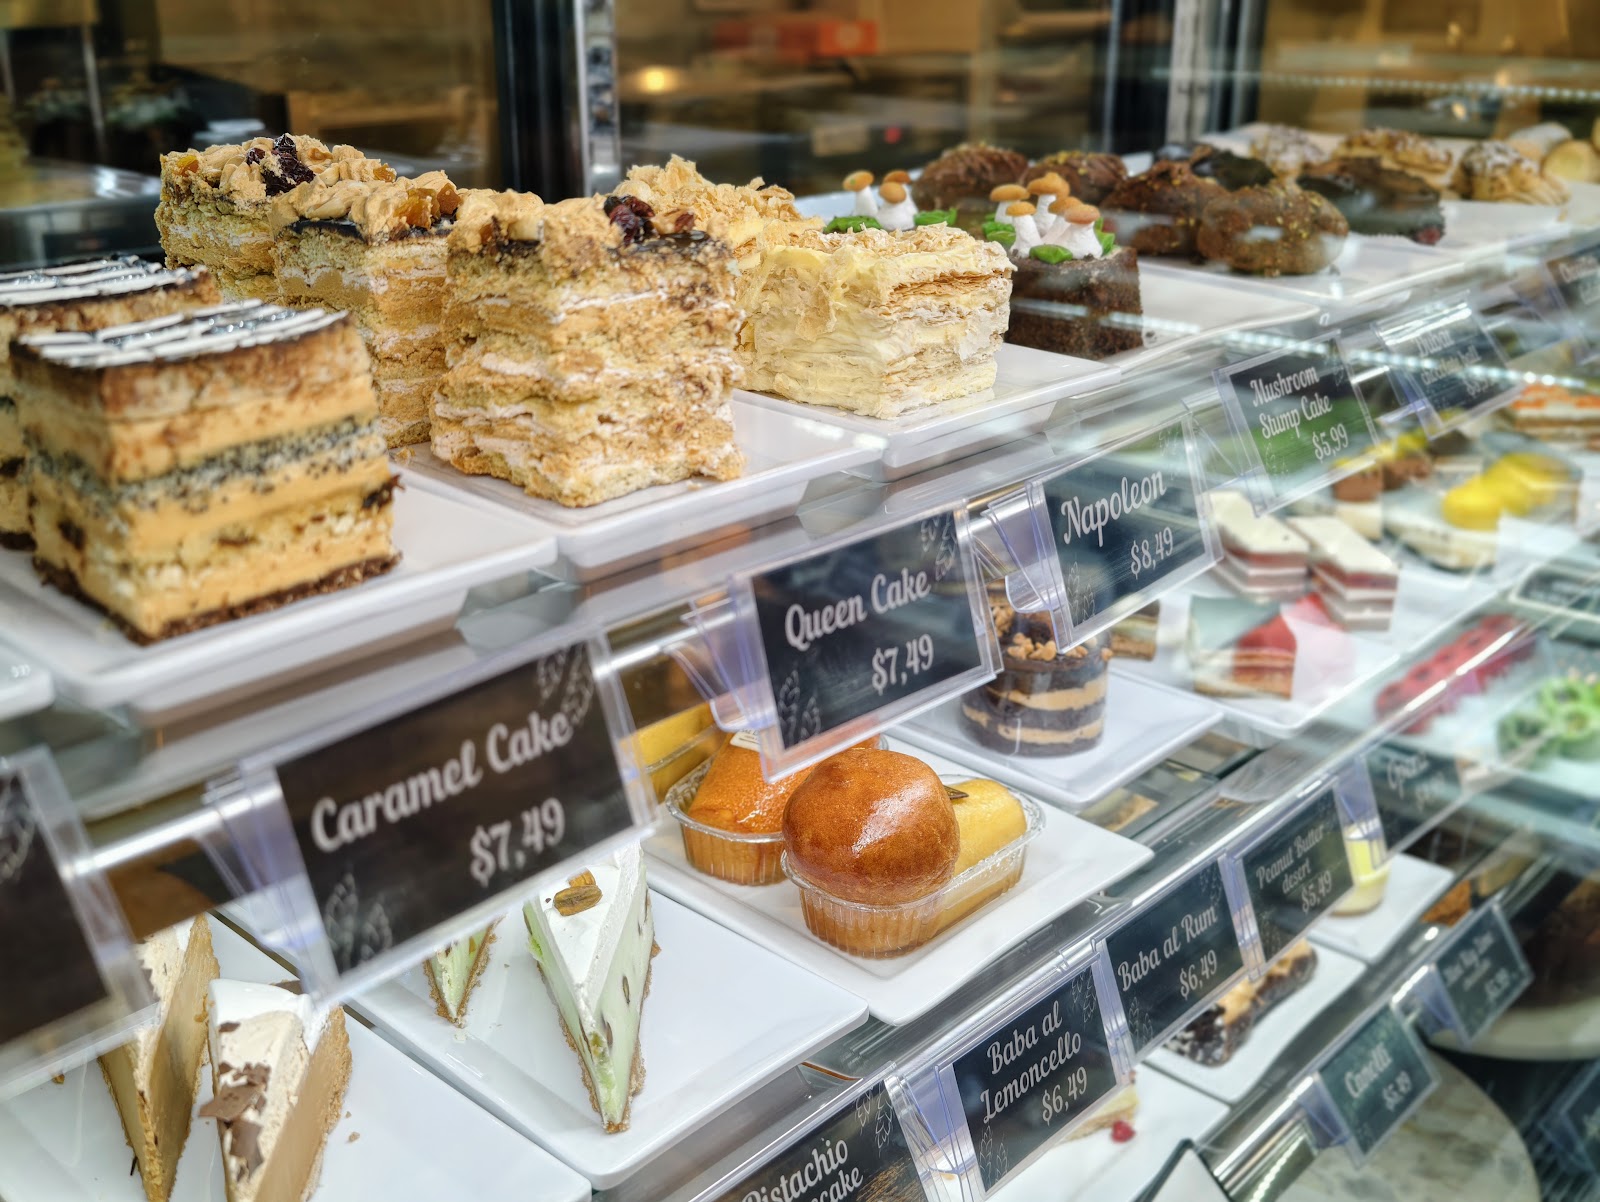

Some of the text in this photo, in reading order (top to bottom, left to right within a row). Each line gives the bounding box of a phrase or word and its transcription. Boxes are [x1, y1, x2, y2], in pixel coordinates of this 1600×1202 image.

[1250, 366, 1320, 407] Mushroom
[1260, 392, 1333, 439] Stump Cake
[1061, 470, 1166, 547] Napoleon
[1130, 526, 1174, 580] $8,49
[785, 567, 931, 651] Queen Cake
[871, 633, 934, 695] $7,49
[310, 711, 573, 853] Caramel Cake
[1256, 824, 1324, 889] Peanut Butter
[1118, 906, 1218, 992] Baba al Rum
[987, 1000, 1063, 1075] Baba al
[979, 1032, 1081, 1124] Lemoncello
[1042, 1066, 1087, 1126] $6,49
